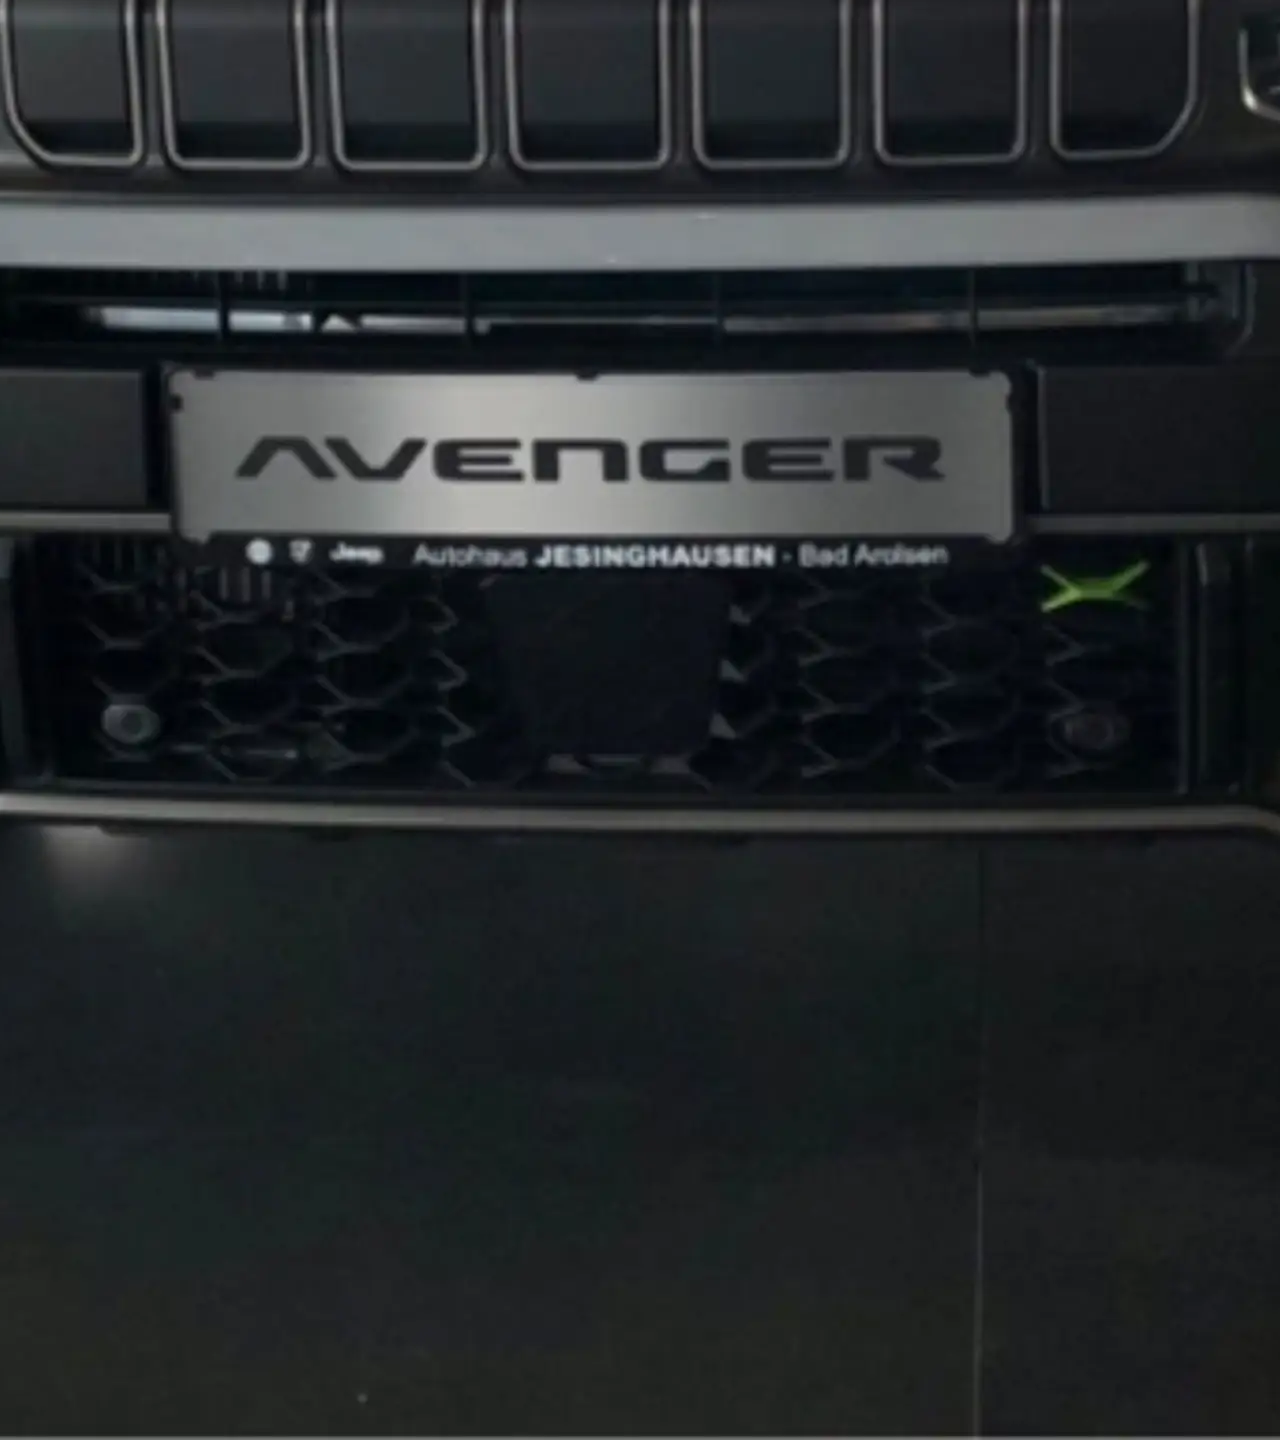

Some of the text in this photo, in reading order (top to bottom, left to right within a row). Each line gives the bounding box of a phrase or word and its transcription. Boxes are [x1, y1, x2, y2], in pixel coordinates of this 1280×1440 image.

[234, 436, 946, 482] AVENGER
[413, 543, 528, 568] Autohaus
[536, 544, 776, 569] JESINGHAUSEN
[798, 543, 848, 568] Bad
[854, 543, 949, 569] Arolsen
